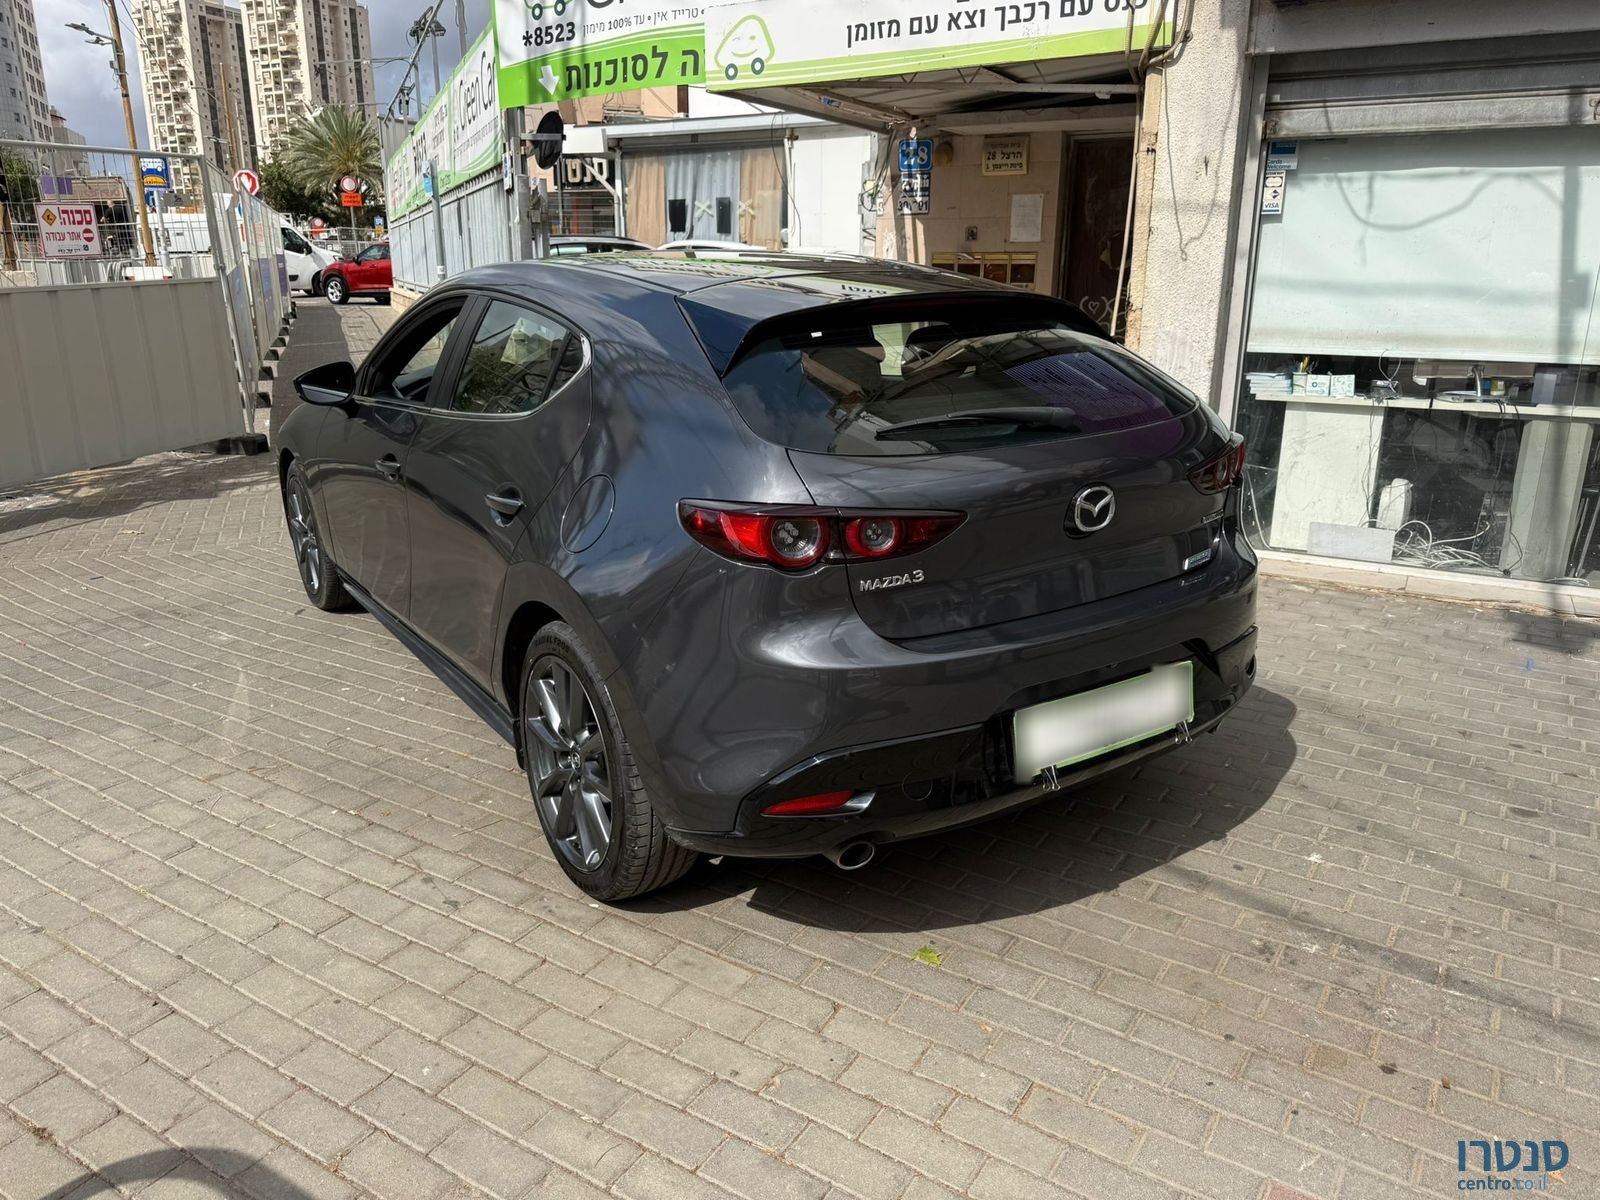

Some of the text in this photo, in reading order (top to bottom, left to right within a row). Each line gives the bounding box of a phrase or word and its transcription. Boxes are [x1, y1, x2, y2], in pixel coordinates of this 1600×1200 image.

[947, 8, 986, 31] וצא
[994, 1, 1050, 31] רכבך
[1060, 0, 1093, 18] עם
[583, 7, 699, 38] טרייד אין עד 100% מימון
[846, 18, 901, 48] מזומן
[909, 14, 939, 36] עם
[565, 45, 669, 92] לסוכנות
[480, 50, 496, 111] Car
[903, 146, 928, 165] 28
[57, 206, 93, 226] סכנה!
[45, 231, 82, 241] אתר עבודה
